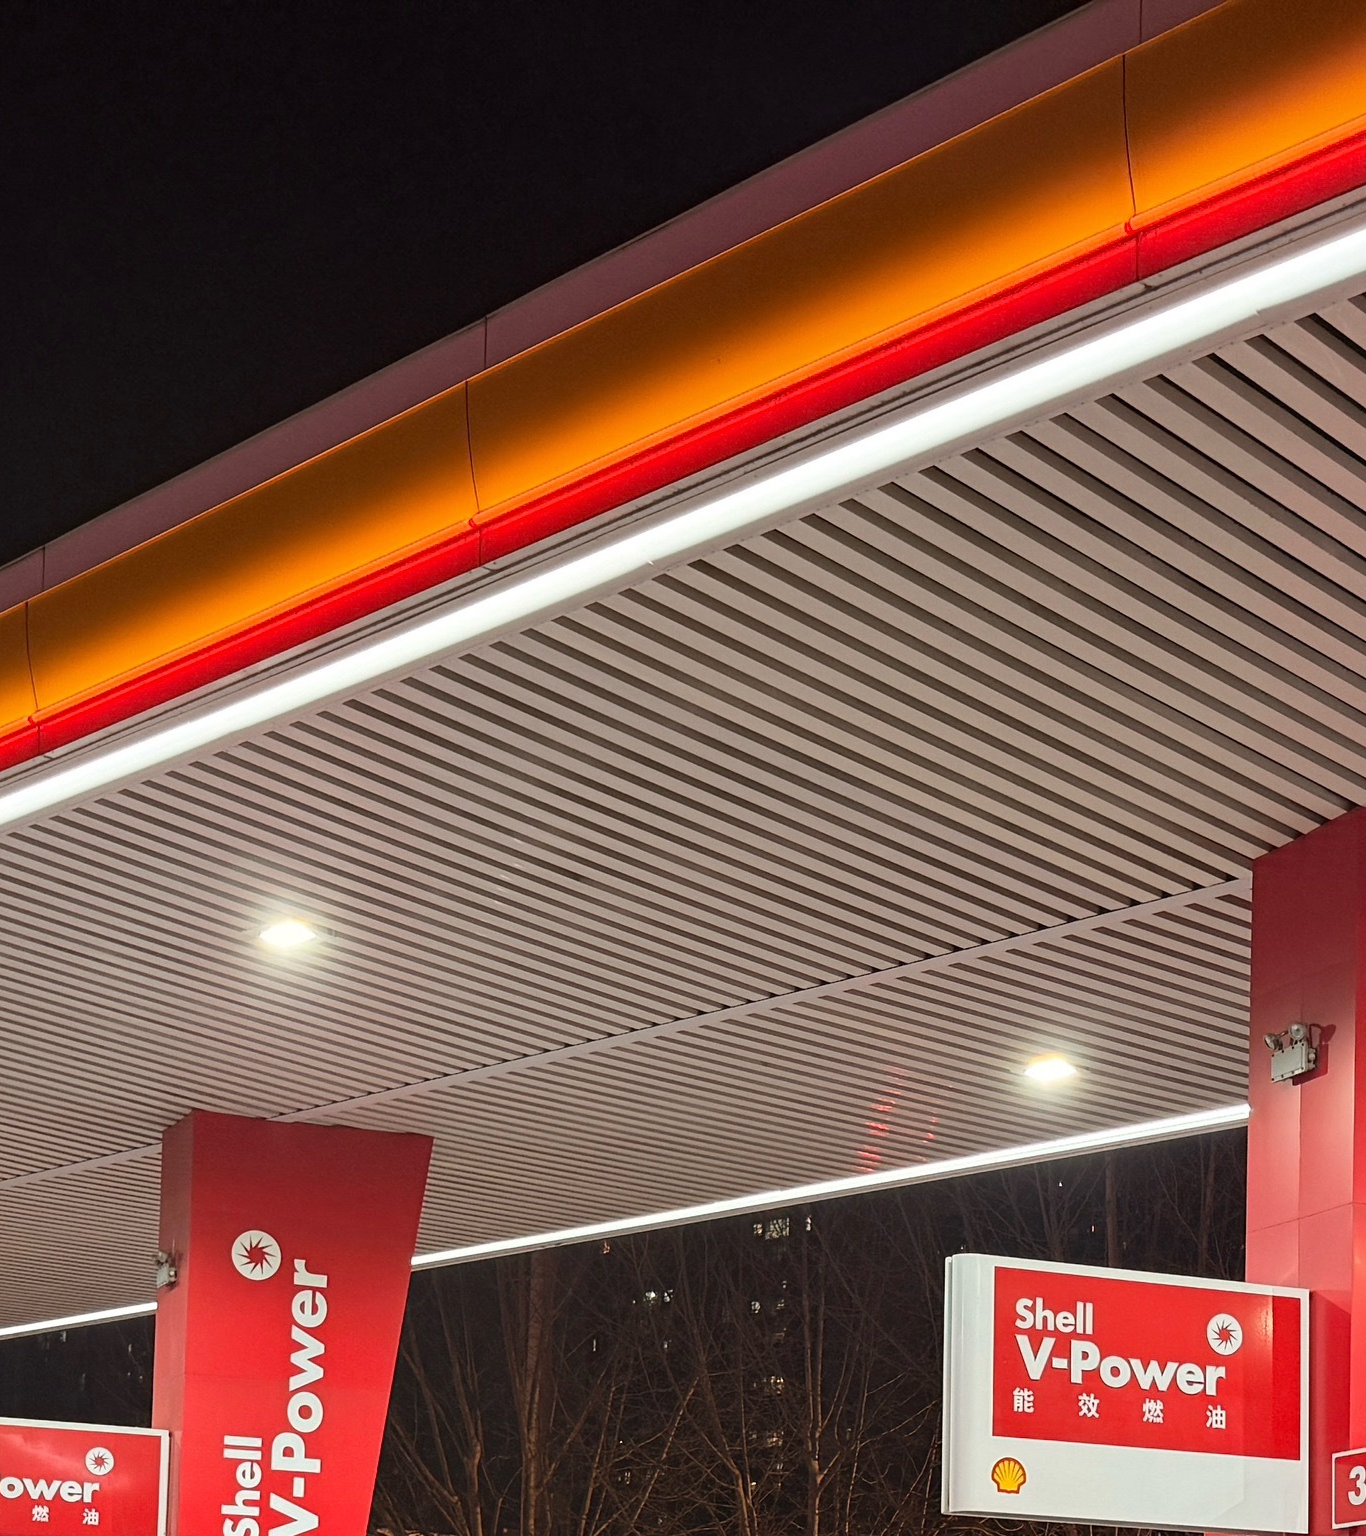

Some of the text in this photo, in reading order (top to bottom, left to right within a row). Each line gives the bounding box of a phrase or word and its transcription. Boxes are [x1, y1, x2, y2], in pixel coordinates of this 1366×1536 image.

[1014, 1297, 1093, 1334] Shell
[1014, 1334, 1226, 1396] V-Power
[1012, 1387, 1226, 1429] 能效燃油
